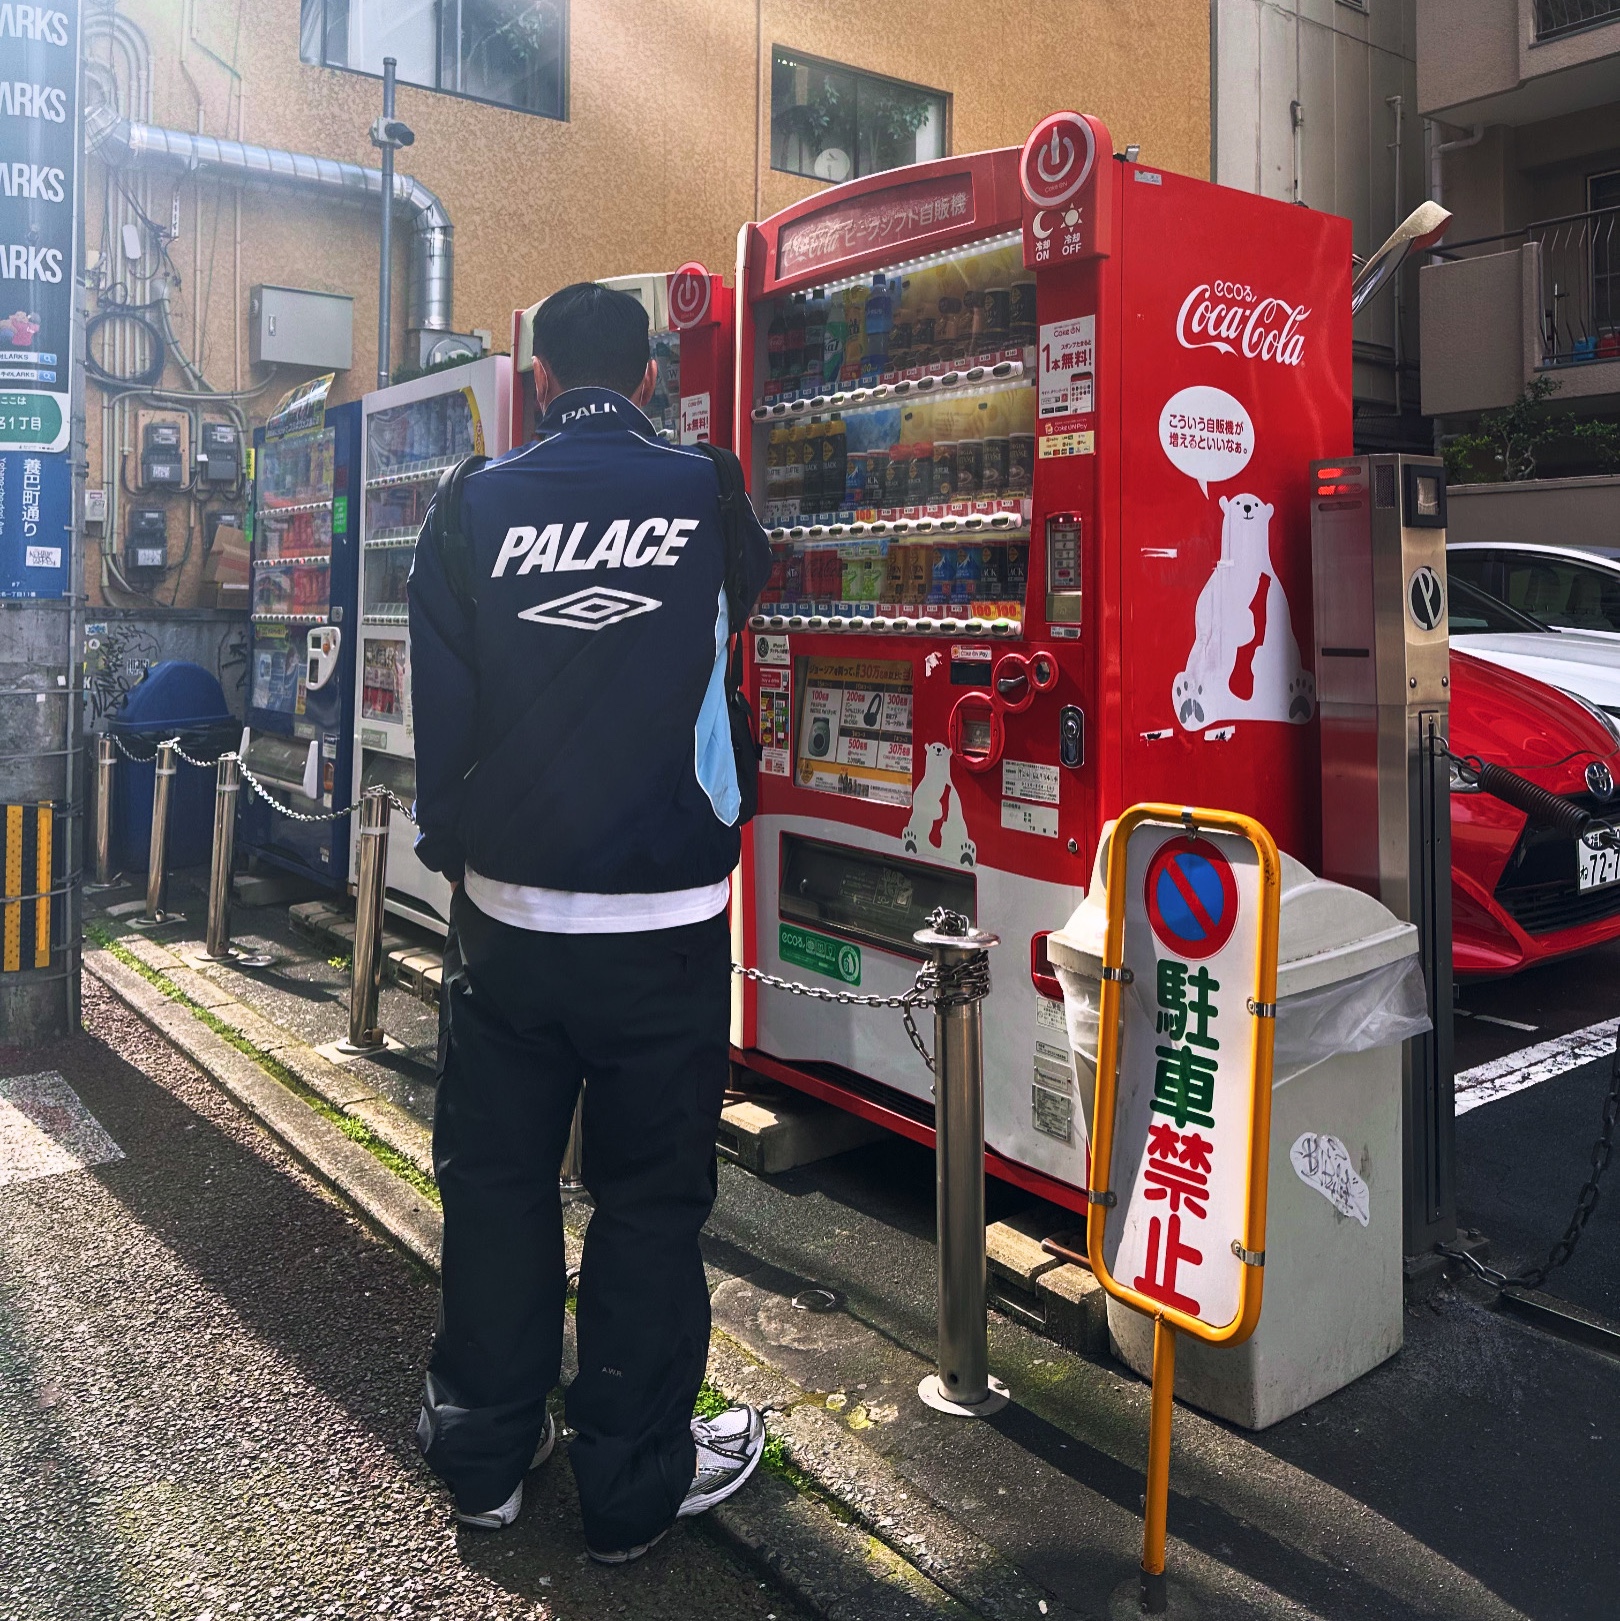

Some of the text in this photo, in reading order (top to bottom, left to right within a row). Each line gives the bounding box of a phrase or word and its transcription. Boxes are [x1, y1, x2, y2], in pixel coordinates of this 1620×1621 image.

[1035, 239, 1051, 252] 冷却
[1062, 243, 1082, 256] OFF
[1064, 232, 1081, 245] 冷却
[1036, 250, 1050, 262] ON
[1176, 284, 1312, 367] Coca-Cola
[1169, 413, 1244, 436] こういう自販機が
[22, 458, 42, 537] 養巴町通り
[491, 517, 701, 578] PALACE
[1133, 958, 1221, 1317] 駐車禁止
